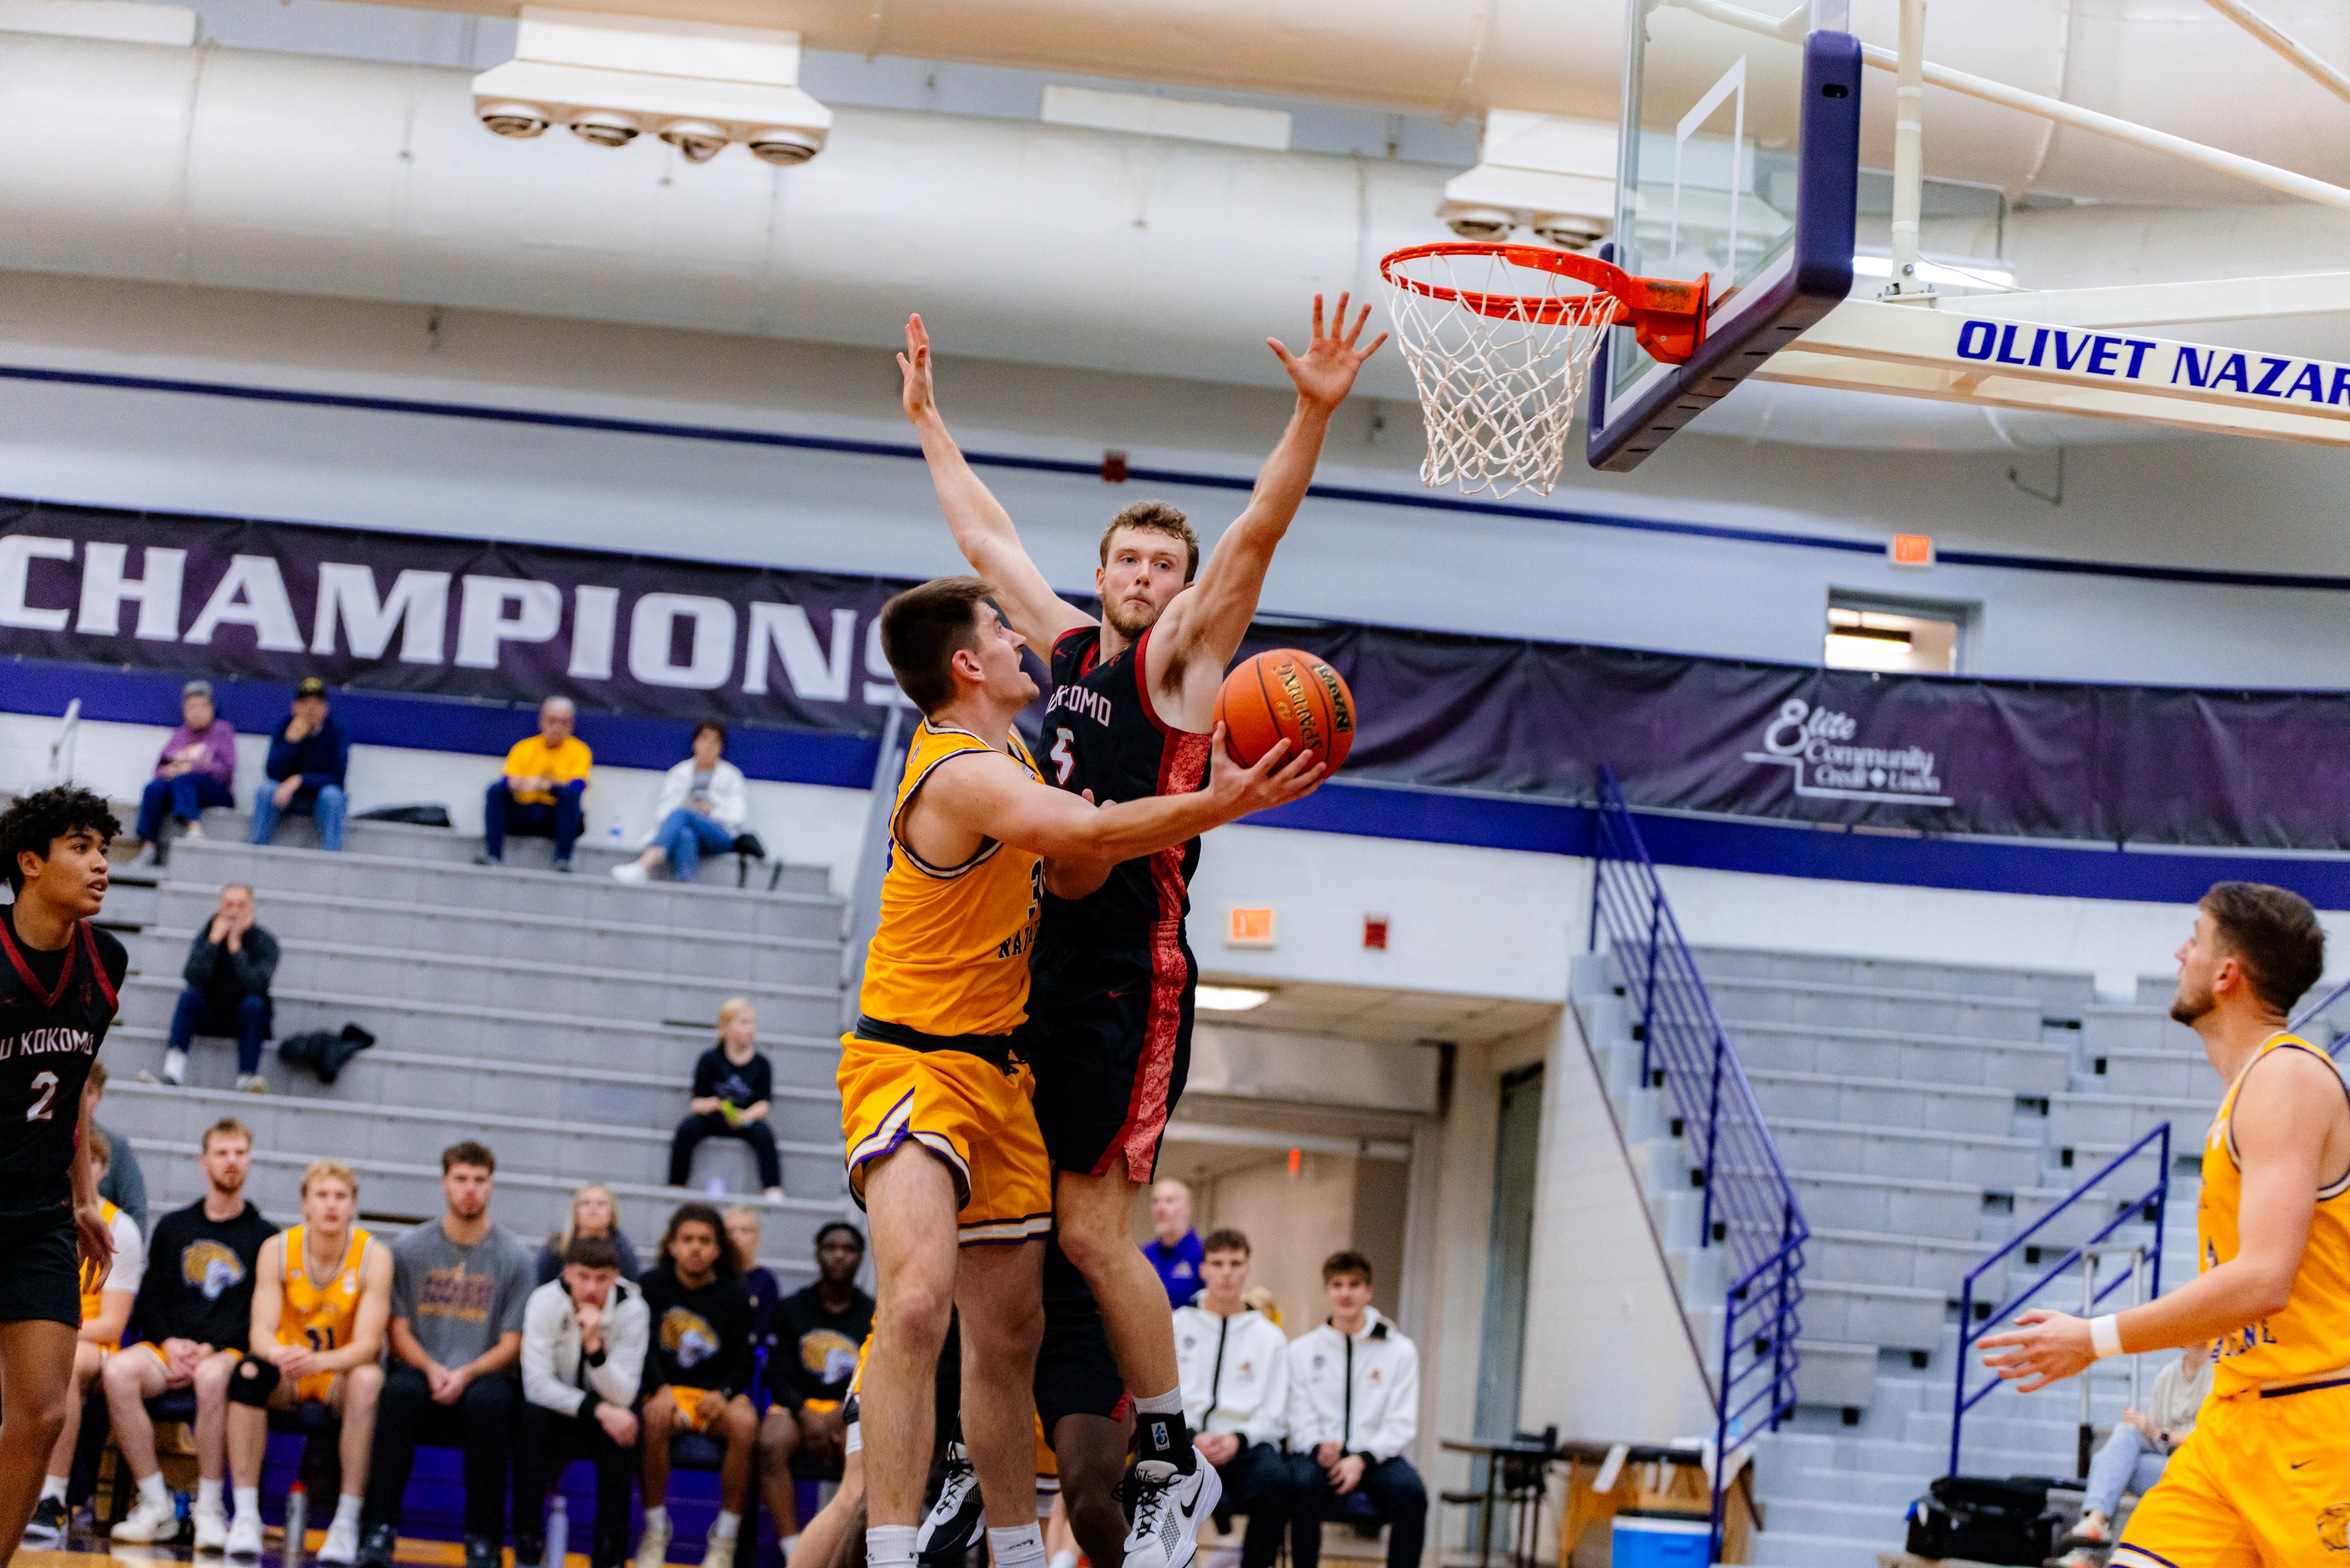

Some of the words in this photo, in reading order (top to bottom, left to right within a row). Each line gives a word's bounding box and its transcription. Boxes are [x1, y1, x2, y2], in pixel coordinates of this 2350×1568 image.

[1956, 318, 2156, 380] OLIVET
[2170, 346, 2350, 406] NAZAR
[1276, 662, 1322, 751] SPALDING
[1764, 698, 1857, 757] Elite
[1049, 726, 1075, 787] 5
[1804, 737, 1935, 777] Community
[1026, 856, 1046, 921] 3
[20, 1027, 94, 1056] KOKOMO
[26, 1070, 60, 1123] 2
